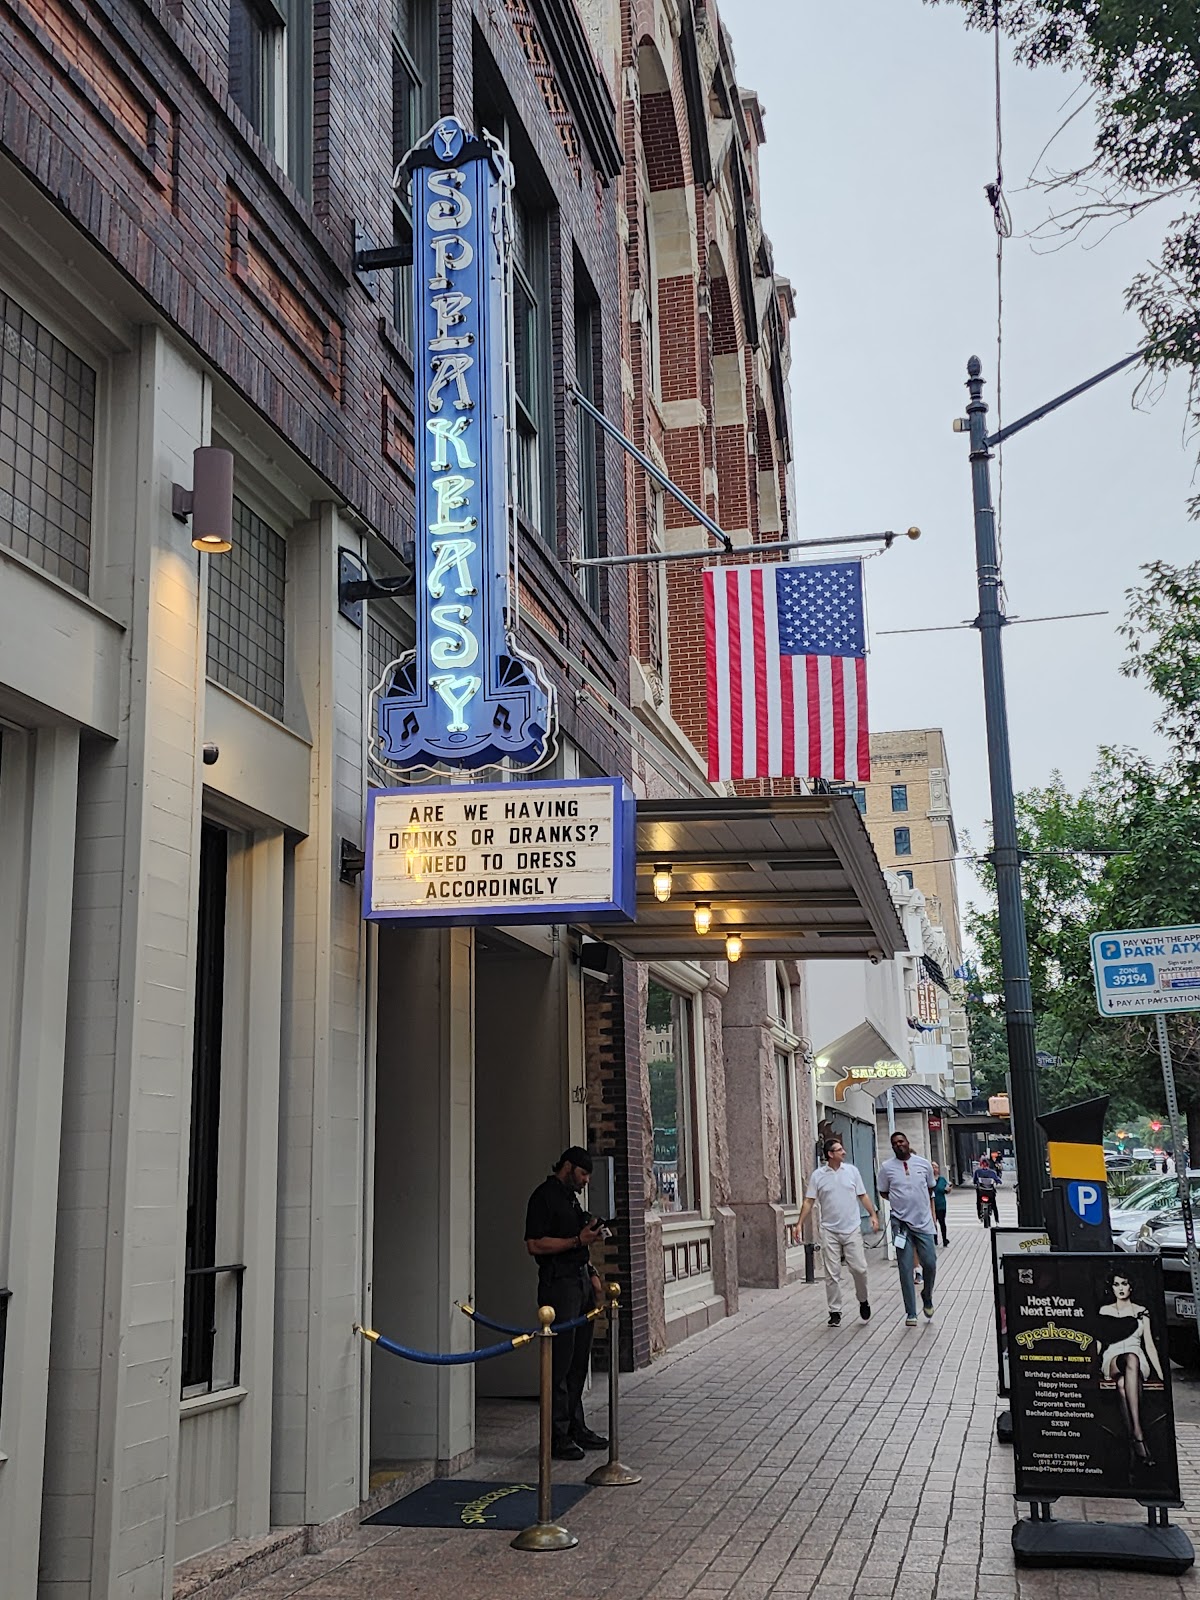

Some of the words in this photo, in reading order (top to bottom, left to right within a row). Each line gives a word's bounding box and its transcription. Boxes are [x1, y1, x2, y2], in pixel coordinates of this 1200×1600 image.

[426, 168, 481, 732] SPEAKEASY
[409, 805, 444, 823] ARE
[464, 804, 489, 821] WE
[505, 800, 579, 820] HAVING
[389, 829, 457, 850] DRINKS
[472, 828, 494, 846] OR
[510, 825, 599, 844] DRANKS?
[406, 855, 414, 874] I
[422, 854, 466, 874] NEED
[481, 853, 503, 871] TO
[518, 850, 577, 870] DRESS
[426, 877, 559, 899] ACCORDINGLY
[1123, 939, 1138, 947] PAY
[1141, 937, 1163, 946] WITH
[1123, 945, 1166, 958] PARK
[1171, 943, 1200, 955] ATX
[1112, 973, 1148, 986] 39194
[1116, 999, 1132, 1007] PAY
[1147, 994, 1200, 1005] PAYSTATION
[851, 1068, 907, 1078] SALOON
[1077, 1186, 1098, 1216] P
[1027, 1295, 1051, 1306] Host
[1052, 1296, 1076, 1307] Your
[1020, 1306, 1044, 1316] Next
[1045, 1307, 1072, 1317] Event
[1073, 1307, 1084, 1317] at
[1015, 1321, 1094, 1351] speakeasy
[1024, 1371, 1051, 1379] Birthday
[1051, 1371, 1091, 1379] Celebrations
[1038, 1381, 1058, 1389] Happy
[1035, 1390, 1058, 1398] Holiday
[1033, 1400, 1064, 1408] Corporate
[1025, 1410, 1095, 1418] Bachelor/Bachelorette
